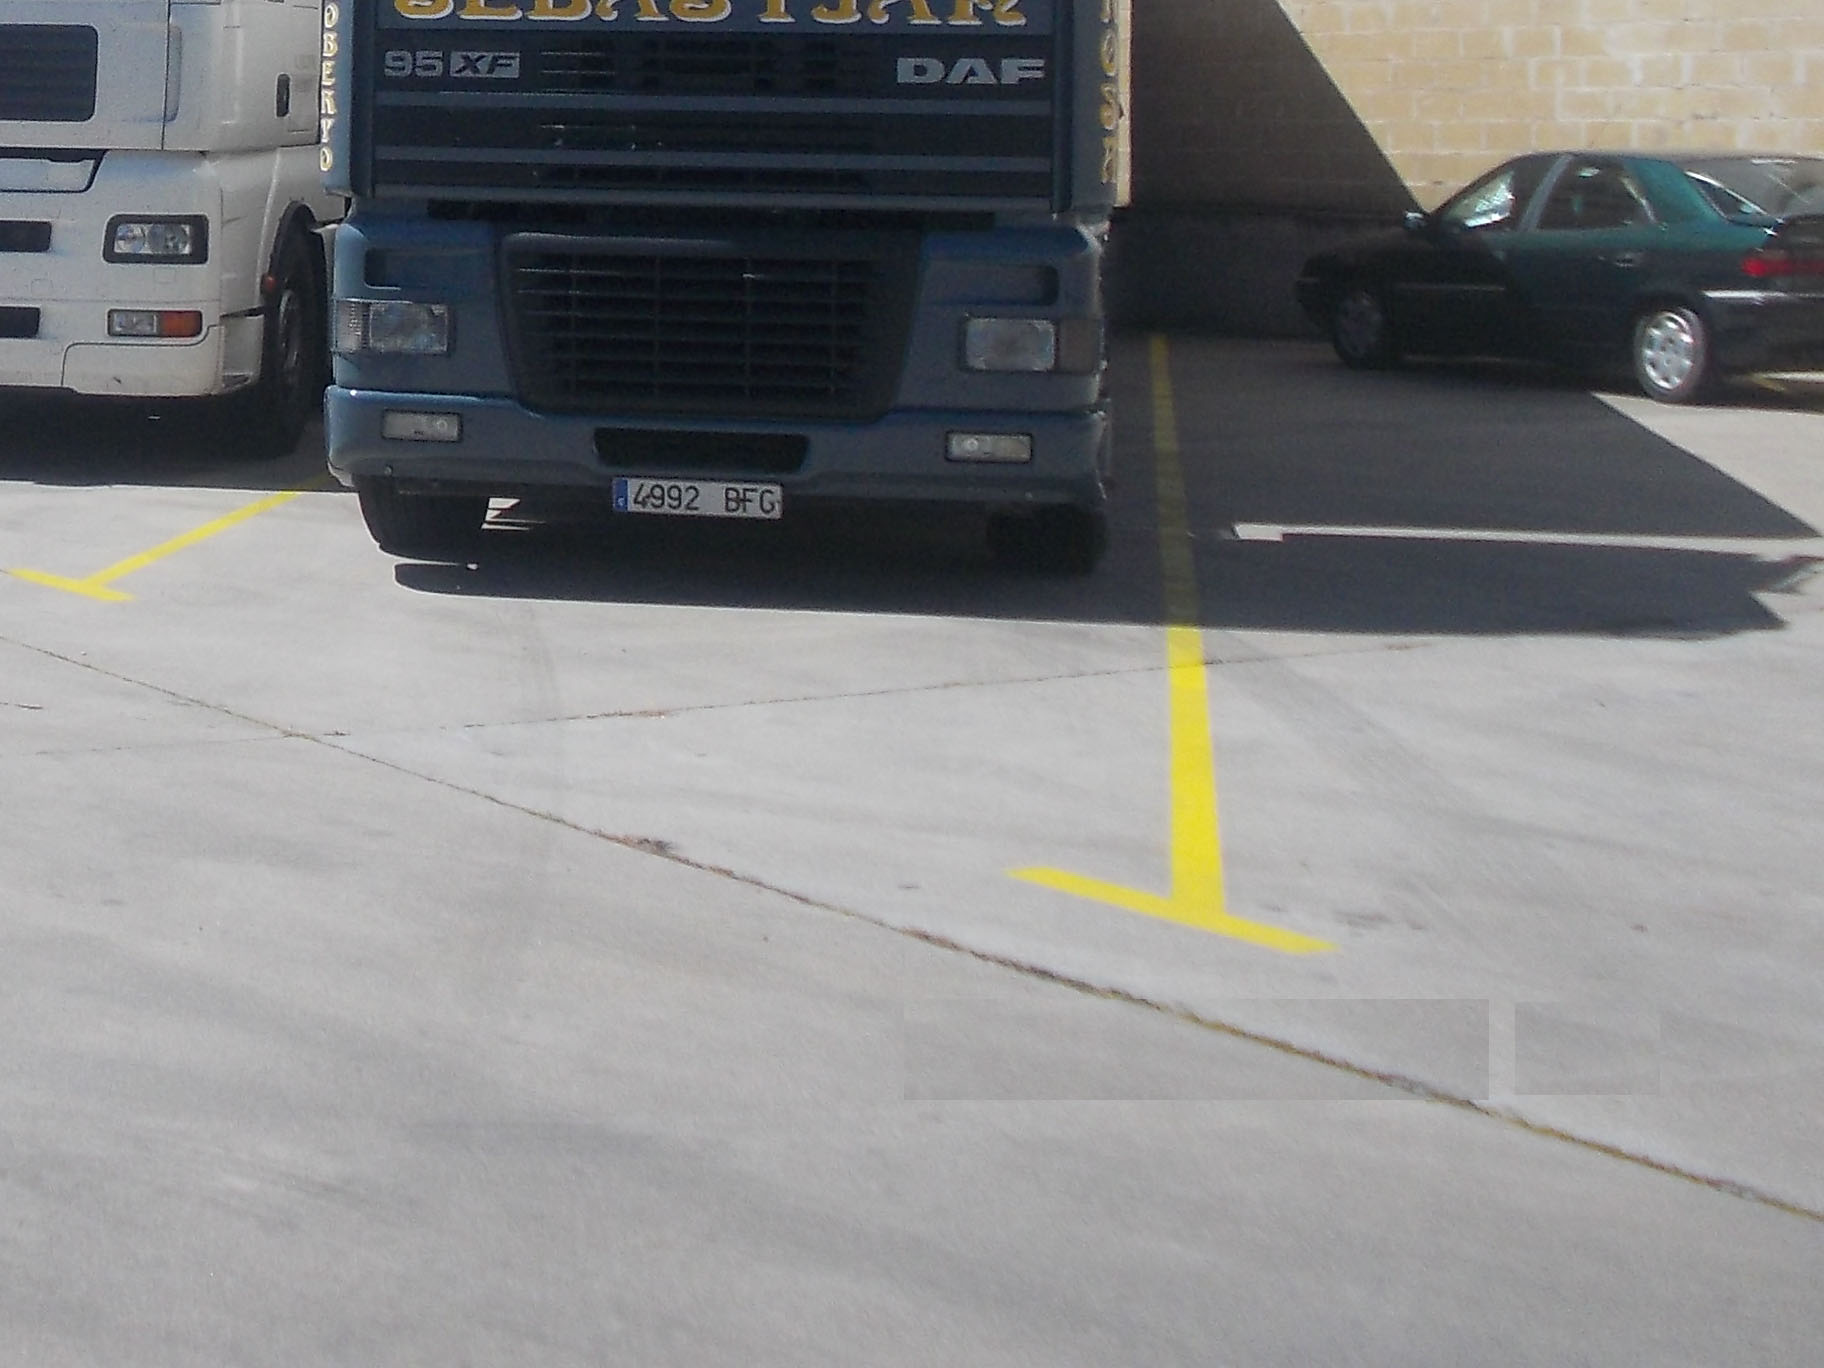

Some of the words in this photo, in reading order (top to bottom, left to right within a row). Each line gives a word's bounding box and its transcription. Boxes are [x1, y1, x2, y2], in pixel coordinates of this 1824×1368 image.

[897, 57, 1045, 85] DAF
[633, 483, 700, 511] 4992
[725, 487, 776, 514] BFG
